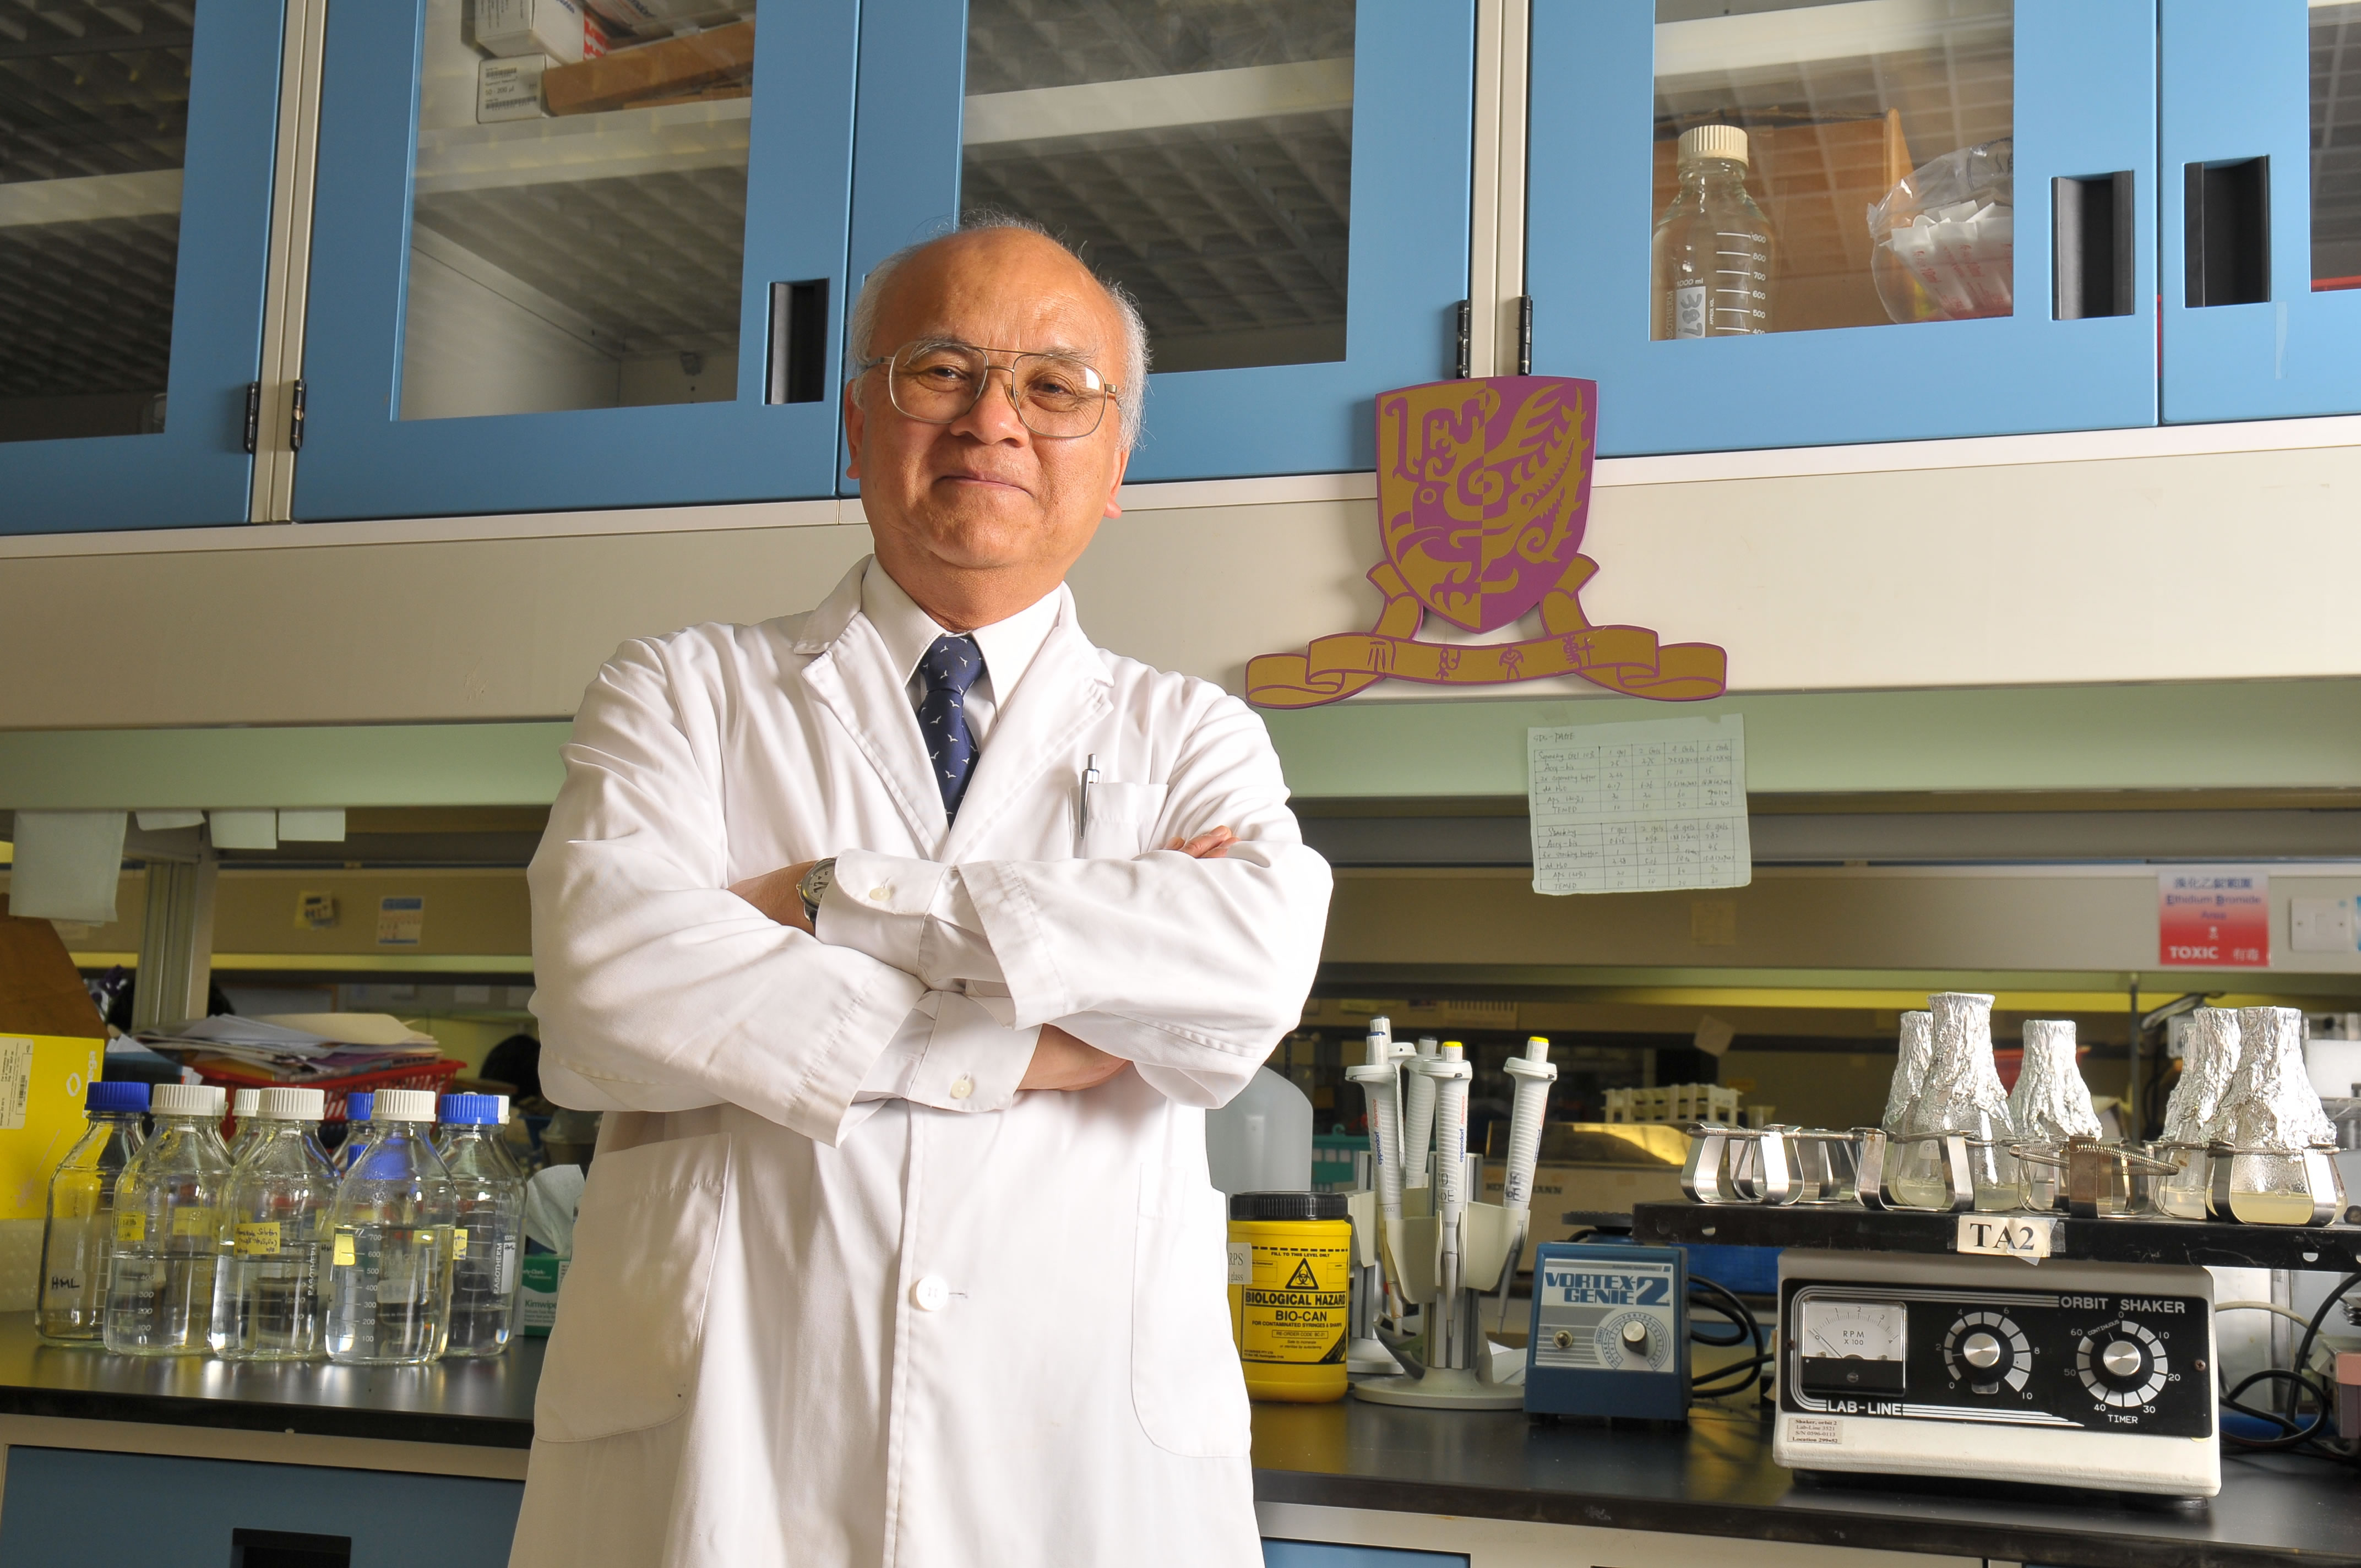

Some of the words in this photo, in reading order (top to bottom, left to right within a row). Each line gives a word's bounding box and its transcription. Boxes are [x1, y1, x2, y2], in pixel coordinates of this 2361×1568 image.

[1753, 253, 1766, 262] 800
[1754, 271, 1766, 281] 700
[1677, 279, 1693, 287] 1000
[1753, 290, 1765, 300] 600
[1753, 309, 1765, 318] 500
[2166, 894, 2212, 906] Ethidium
[2216, 895, 2261, 906] Bromide
[2201, 911, 2227, 920] Area
[2169, 945, 2219, 959] TOXIC
[1375, 1131, 1383, 1165] eppendorf
[1970, 1223, 2034, 1250] TA2
[308, 1243, 318, 1296] RASOTHERM
[494, 1243, 503, 1294] RASOTHERM
[51, 1277, 80, 1290] HML
[1231, 1272, 1243, 1283] glass
[1564, 1288, 1634, 1305] GENIE
[1636, 1276, 1670, 1306] 2
[1245, 1292, 1312, 1306] BIOLOGICAL
[1315, 1293, 1346, 1306] HAZARD
[2061, 1297, 2108, 1310] ORBIT
[2120, 1299, 2185, 1314] SHAKER
[1275, 1310, 1327, 1322] BIO-CAN
[2087, 1320, 2120, 1336] CONTINUOUS
[1828, 1400, 1902, 1416] LAB-LINE
[2108, 1414, 2138, 1424] TIMER
